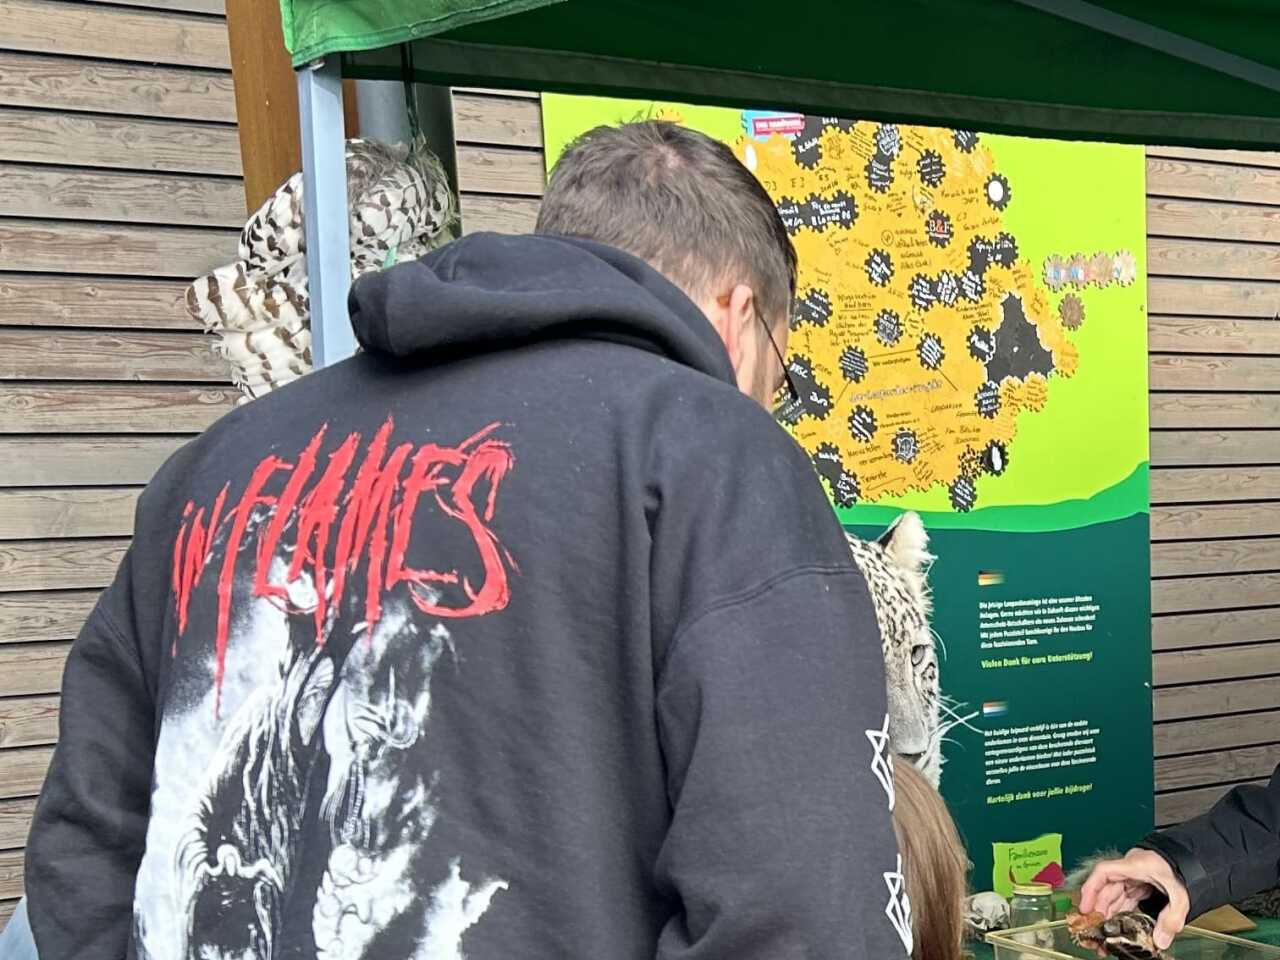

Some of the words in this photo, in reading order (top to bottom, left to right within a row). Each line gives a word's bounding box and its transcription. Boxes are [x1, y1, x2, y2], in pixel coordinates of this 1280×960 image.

[214, 413, 521, 720] FLAMES
[1003, 657, 1020, 667] Dank
[1021, 656, 1031, 665] für
